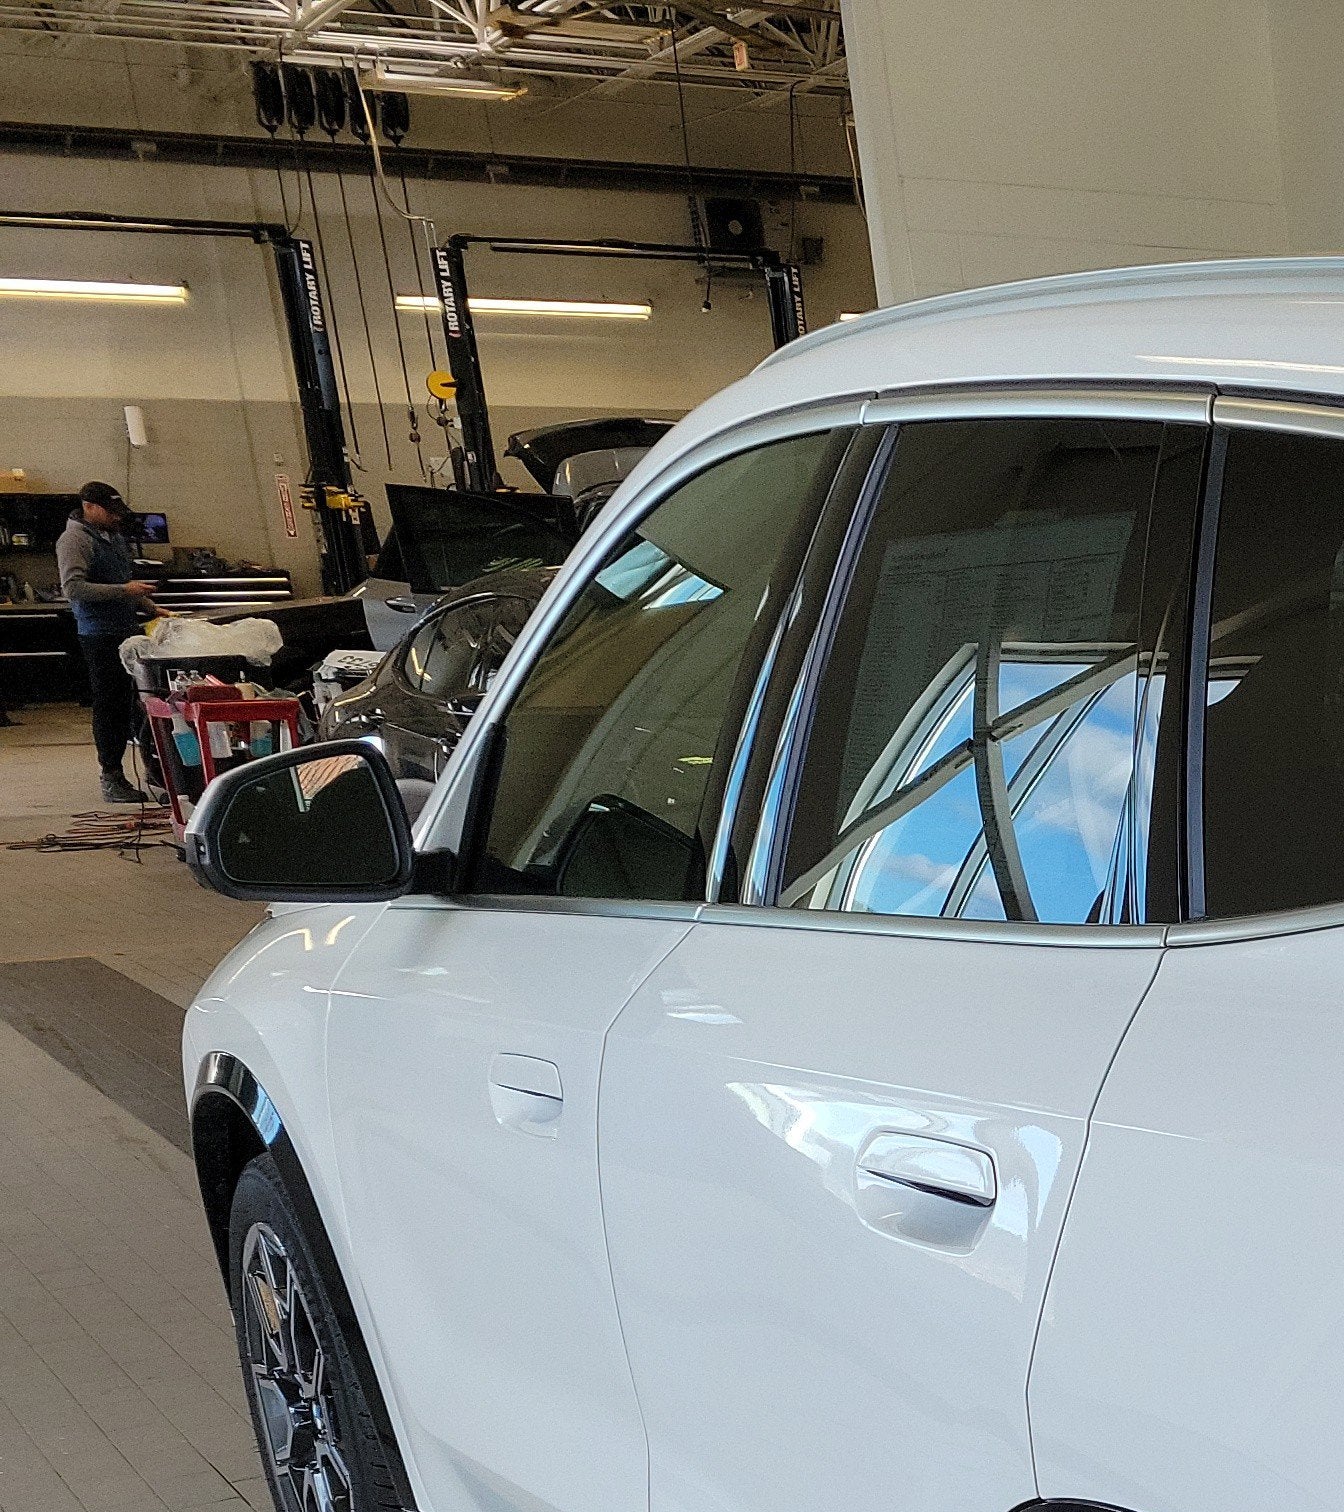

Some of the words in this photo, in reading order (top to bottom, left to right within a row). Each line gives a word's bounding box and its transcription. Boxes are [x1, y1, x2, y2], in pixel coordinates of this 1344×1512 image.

[300, 241, 313, 270] LIFT
[436, 250, 450, 277] LIFT
[305, 272, 323, 330] ROTARY
[441, 279, 460, 331] ROTARY
[794, 294, 806, 335] OTARY
